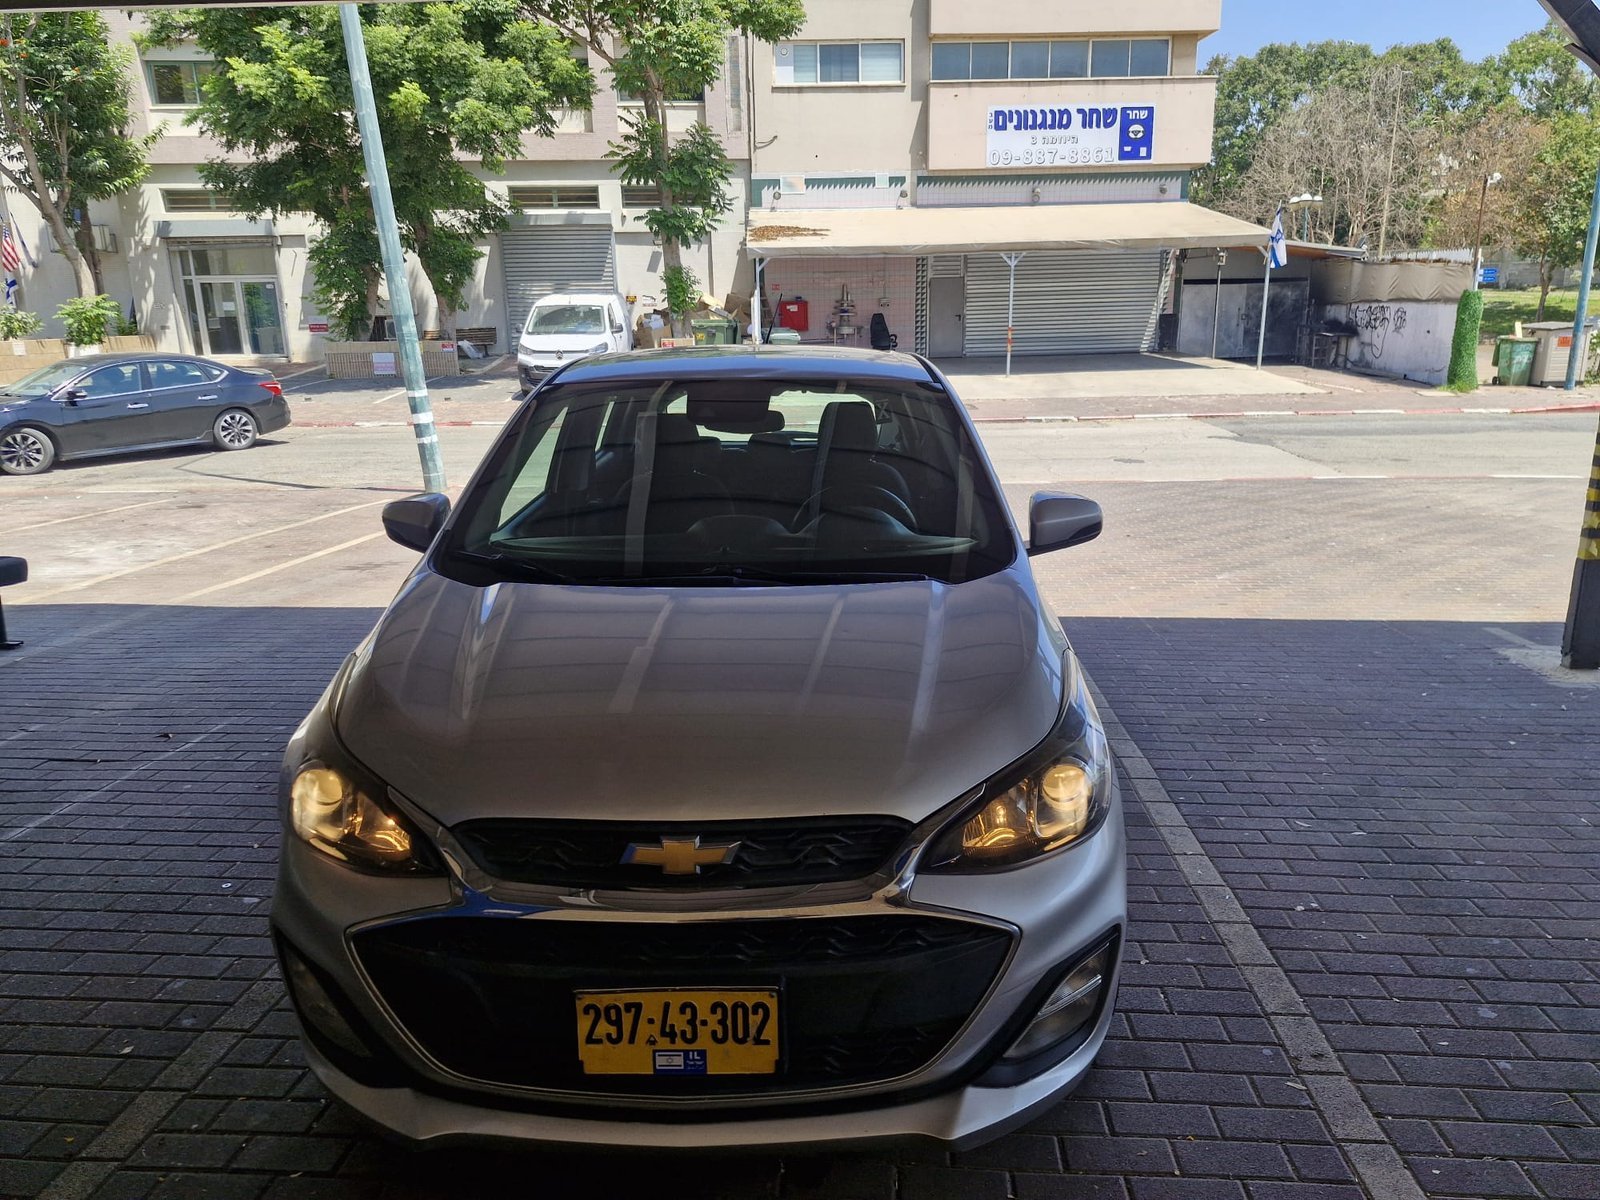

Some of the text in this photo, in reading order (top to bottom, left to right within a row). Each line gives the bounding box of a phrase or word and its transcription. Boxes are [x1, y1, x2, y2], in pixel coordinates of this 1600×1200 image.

[993, 108, 1118, 131] שחר מנגנונים
[1126, 110, 1148, 120] שחר
[990, 147, 1115, 165] 09-887-8861
[689, 1051, 701, 1060] IL
